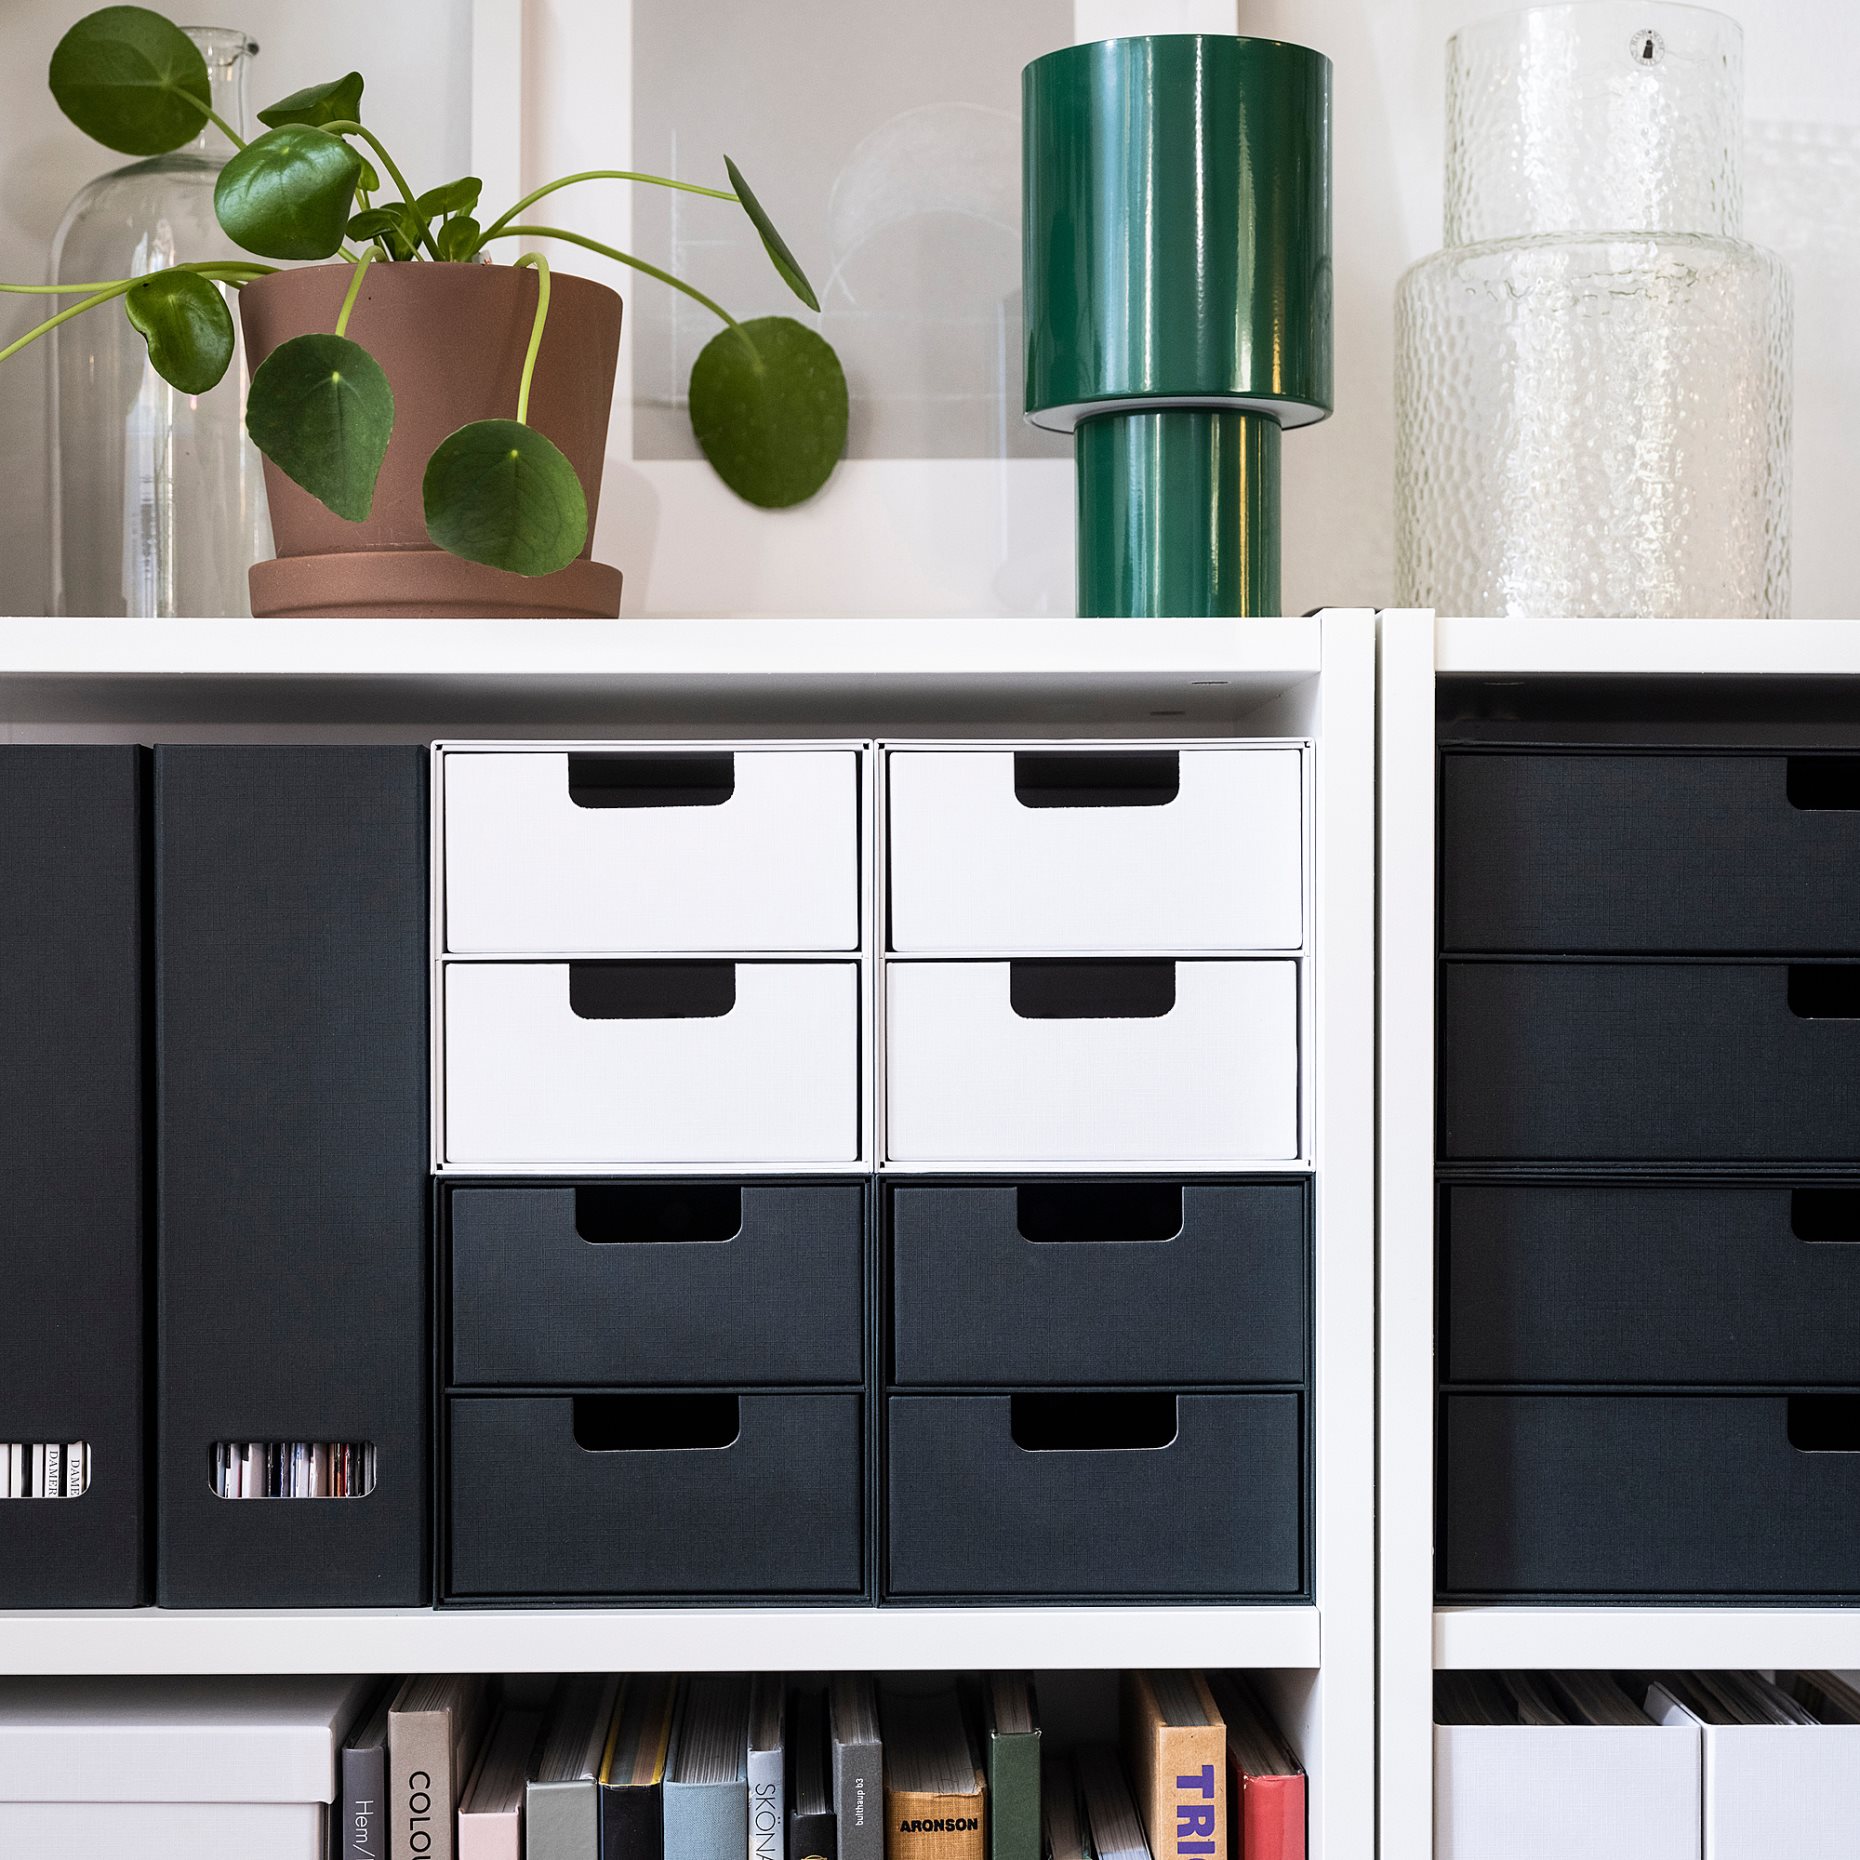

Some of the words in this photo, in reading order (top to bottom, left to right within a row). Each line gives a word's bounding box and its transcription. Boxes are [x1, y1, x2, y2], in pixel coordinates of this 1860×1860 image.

[48, 1451, 58, 1495] DAMER
[855, 1778, 864, 1789] b3
[409, 1771, 431, 1860] COLO
[855, 1789, 866, 1826] bulthaup
[900, 1818, 978, 1832] ARONSON
[1177, 1765, 1215, 1860] TRI
[352, 1800, 376, 1860] Hem/
